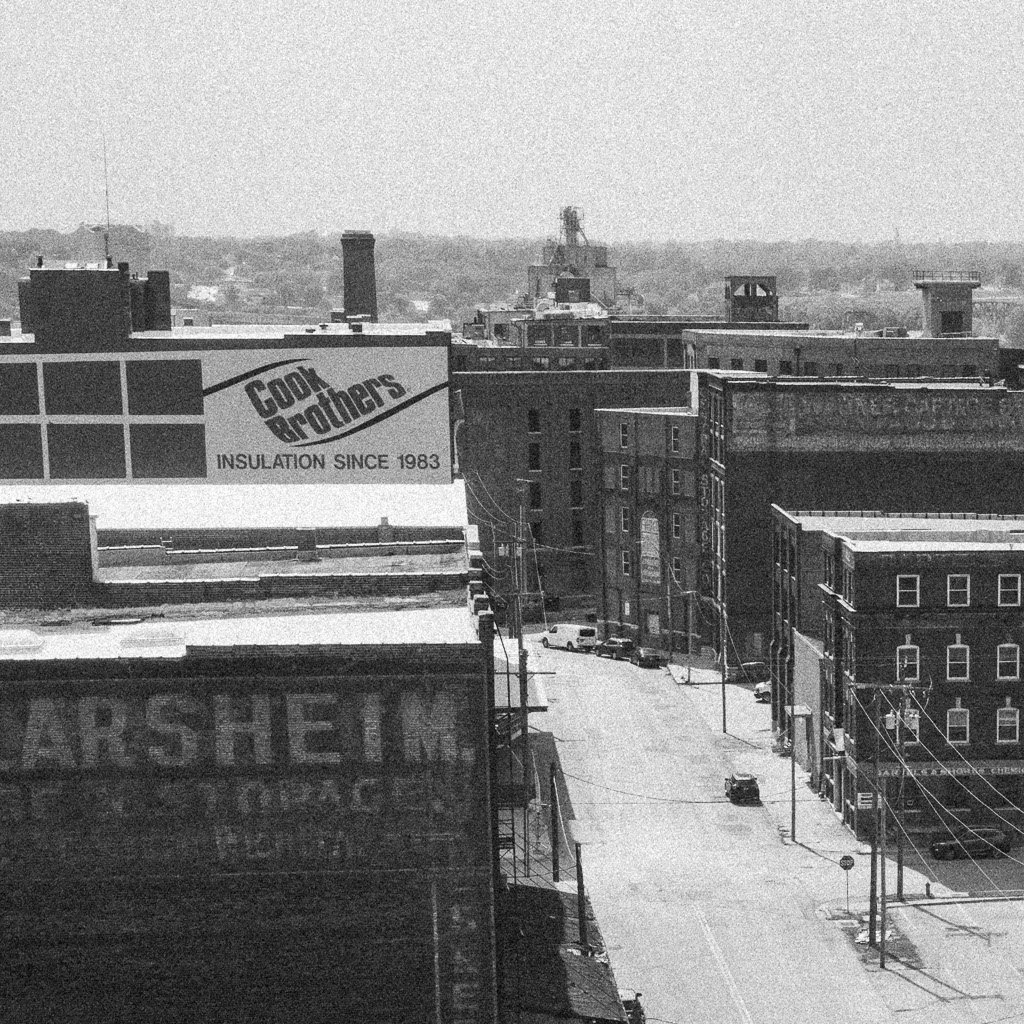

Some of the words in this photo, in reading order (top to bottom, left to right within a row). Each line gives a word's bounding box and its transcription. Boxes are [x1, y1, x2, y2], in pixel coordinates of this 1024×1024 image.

[244, 366, 331, 419] Cook
[264, 374, 407, 444] Brothers
[216, 453, 326, 471] INSULATION
[333, 454, 389, 470] SINCE
[396, 454, 441, 470] 1983
